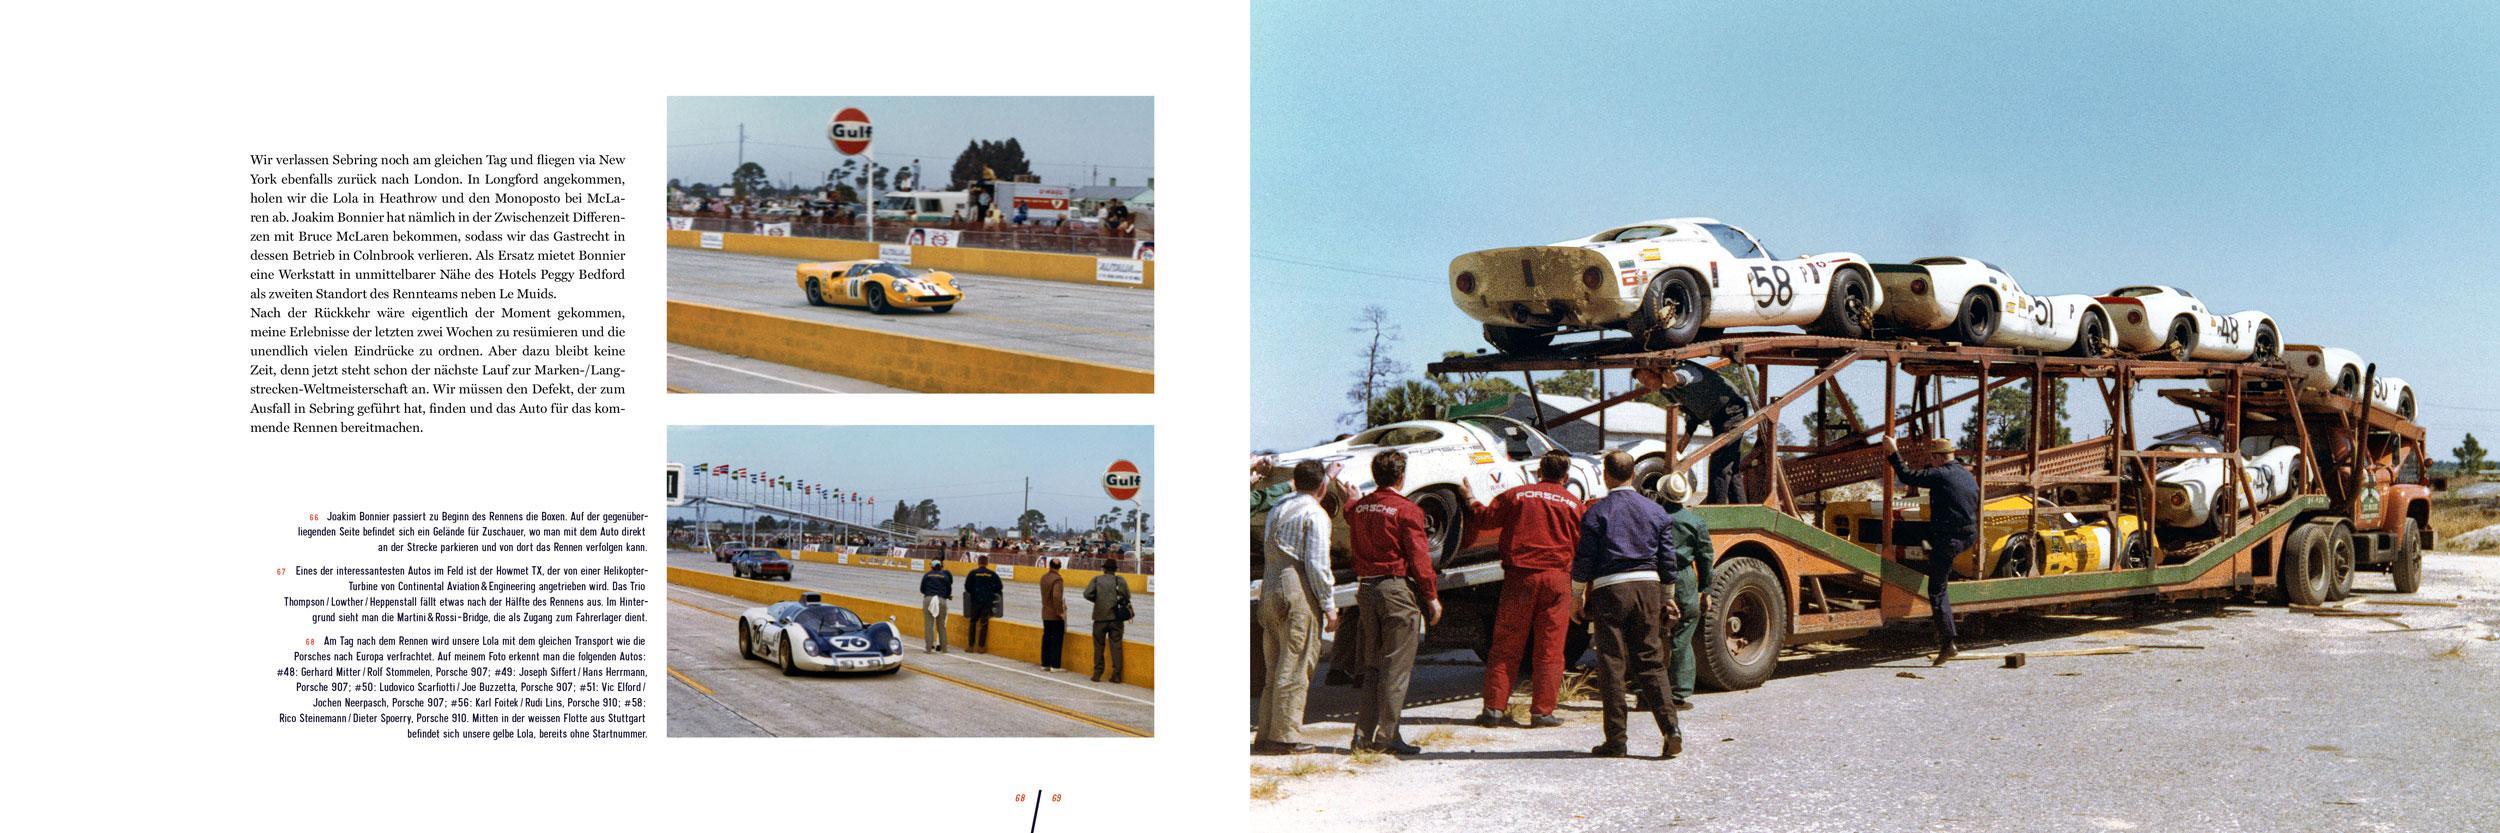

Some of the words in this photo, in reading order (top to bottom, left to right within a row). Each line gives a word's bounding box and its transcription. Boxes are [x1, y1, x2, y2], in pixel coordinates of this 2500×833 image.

[832, 123, 873, 138] Gulf
[250, 154, 273, 165] Wir
[276, 154, 329, 165] verlassen
[332, 154, 378, 168] Sebring
[381, 154, 409, 165] noch
[413, 157, 431, 165] am
[434, 154, 483, 168] gleichen
[486, 154, 507, 168] Tag
[510, 154, 533, 165] und
[537, 154, 575, 168] fliegen
[578, 154, 596, 165] via
[599, 154, 626, 165] New
[250, 173, 277, 184] York
[281, 173, 333, 184] ebenfalls
[337, 173, 377, 185] zurück
[381, 173, 409, 184] nach
[414, 173, 463, 184] London.
[468, 174, 480, 184] In
[485, 173, 539, 187] Longford
[543, 173, 625, 187] angekommen,
[250, 192, 283, 204] holen
[287, 192, 307, 203] wir
[310, 192, 329, 204] die
[333, 192, 359, 204] Lola
[363, 192, 374, 203] in
[380, 192, 437, 204] Heathrow
[441, 192, 464, 204] und
[468, 192, 490, 204] den
[495, 193, 561, 206] Monoposto
[565, 192, 582, 204] bei
[587, 193, 625, 204] McLa-
[251, 215, 269, 223] ren
[272, 211, 289, 223] ab.
[291, 211, 334, 223] Joakim
[337, 212, 385, 223] Bonnier
[386, 211, 405, 223] hat
[408, 211, 456, 223] nämlich
[458, 212, 470, 223] in
[472, 211, 492, 223] der
[494, 211, 570, 223] Zwischenzeit
[573, 211, 625, 223] Differen-
[250, 234, 270, 242] zen
[274, 231, 294, 242] mit
[299, 231, 332, 242] Bruce
[336, 231, 389, 242] McLaren
[393, 230, 461, 243] bekommen,
[465, 230, 503, 242] sodass
[507, 230, 526, 242] wir
[529, 230, 550, 242] das
[553, 230, 610, 242] Gastrecht
[614, 230, 625, 242] in
[1799, 266, 1808, 283] P
[1751, 265, 1793, 308] 58
[250, 288, 266, 299] als
[268, 288, 313, 299] zweiten
[316, 288, 367, 299] Standort
[369, 288, 389, 299] des
[393, 288, 458, 299] Rennteams
[461, 288, 496, 299] neben
[500, 288, 514, 299] Le
[517, 288, 557, 299] Muids.
[250, 307, 281, 318] Nach
[287, 307, 307, 318] der
[314, 307, 371, 318] Rückkehr
[376, 307, 405, 318] wäre
[411, 307, 468, 321] eigentlich
[475, 307, 495, 318] der
[501, 307, 551, 318] Moment
[557, 307, 625, 321] gekommen,
[2069, 303, 2075, 319] P
[2220, 315, 2239, 344] 48
[250, 383, 408, 394] strecken-Weltmeisterschaft
[411, 386, 429, 394] an.
[432, 383, 456, 394] Wir
[459, 383, 503, 394] müssen
[506, 383, 528, 394] den
[532, 383, 574, 396] Defekt,
[577, 383, 597, 394] der
[600, 386, 625, 394] zum
[250, 421, 290, 433] mende
[293, 422, 338, 433] Rennen
[340, 421, 423, 433] bereitmachen.
[1106, 474, 1141, 487] Gulf
[1592, 465, 1602, 485] P
[1516, 490, 1578, 509] PORSCHE
[1354, 504, 1398, 516] ORSCHE
[326, 511, 356, 521] Joakim
[359, 511, 390, 521] Bonnier
[393, 512, 426, 523] passiert
[442, 511, 469, 524] Beginn
[471, 511, 486, 521] des
[489, 511, 523, 521] Rennens
[526, 512, 539, 521] die
[541, 511, 567, 521] Boxen.
[570, 511, 584, 521] Auf
[587, 511, 600, 521] der
[603, 511, 648, 524] gegenüber-
[378, 544, 388, 552] an
[390, 542, 404, 552] der
[407, 542, 438, 552] Strecke
[440, 542, 479, 554] parkieren
[481, 542, 497, 552] und
[499, 544, 514, 552] von
[516, 542, 533, 552] dort
[536, 542, 551, 552] das
[553, 542, 583, 552] Rennen
[586, 542, 623, 554] verfolgen
[626, 542, 647, 552] kann.
[305, 638, 314, 646] 68
[324, 635, 337, 646] Am
[340, 636, 354, 648] Tag
[357, 636, 376, 646] nach
[379, 636, 396, 646] dem
[399, 636, 428, 646] Rennen
[431, 636, 449, 646] wird
[452, 638, 480, 646] unsere
[482, 636, 499, 646] Lola
[502, 636, 516, 646] mit
[518, 636, 535, 646] dem
[538, 636, 572, 648] gleichen
[574, 636, 613, 648] Transport
[616, 636, 631, 646] wie
[633, 636, 645, 646] die
[834, 637, 867, 648] 76
[407, 728, 440, 738] befindet
[443, 729, 460, 738] sich
[462, 731, 490, 739] unsere
[492, 729, 514, 741] gelbe
[517, 729, 536, 739] Lola,
[539, 729, 568, 738] bereits
[570, 729, 590, 739] ohne
[592, 728, 647, 739] Startnummer.
[1015, 794, 1026, 802] 68
[1051, 794, 1062, 802] 69
